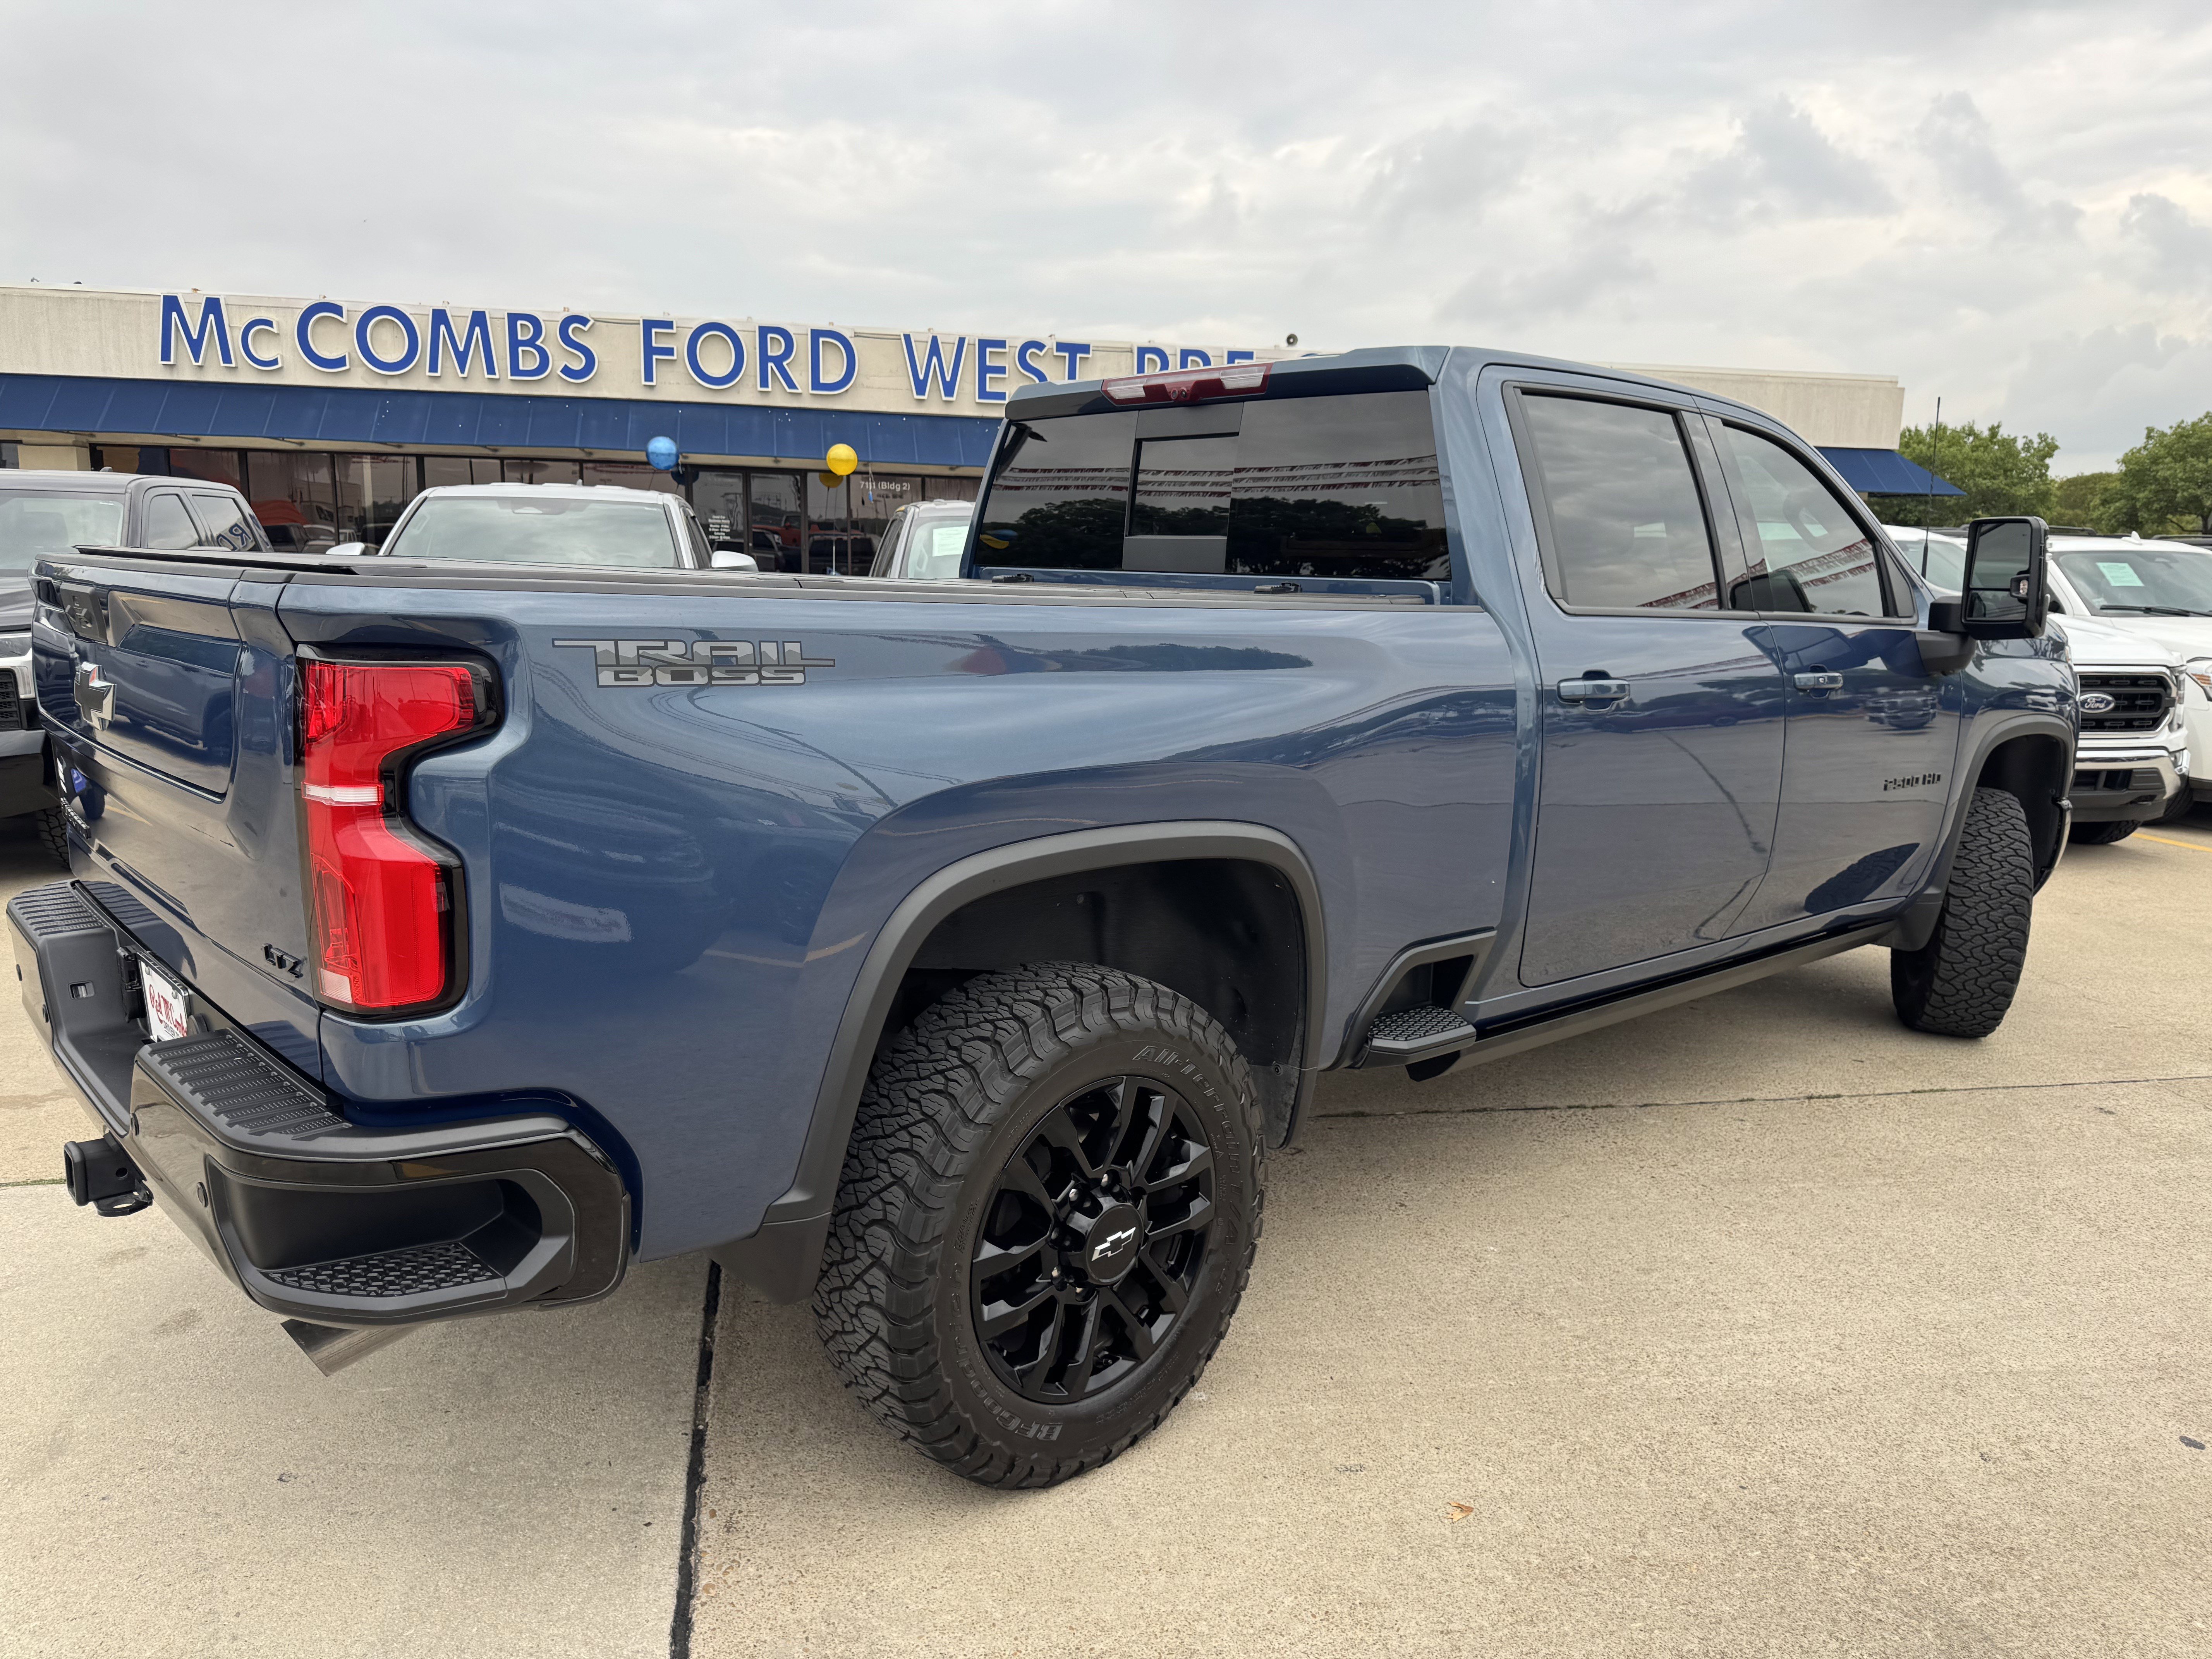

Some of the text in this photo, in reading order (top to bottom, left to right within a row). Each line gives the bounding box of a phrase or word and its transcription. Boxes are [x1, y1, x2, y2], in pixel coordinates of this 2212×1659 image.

[639, 316, 859, 396] FORD
[900, 331, 1092, 404] WEST
[878, 481, 901, 492] (Bldg
[903, 482, 910, 491] 2)
[552, 638, 836, 666] TRAIL
[596, 665, 806, 688] BOSS
[2085, 697, 2107, 709] Ford
[263, 943, 304, 979] LTZ
